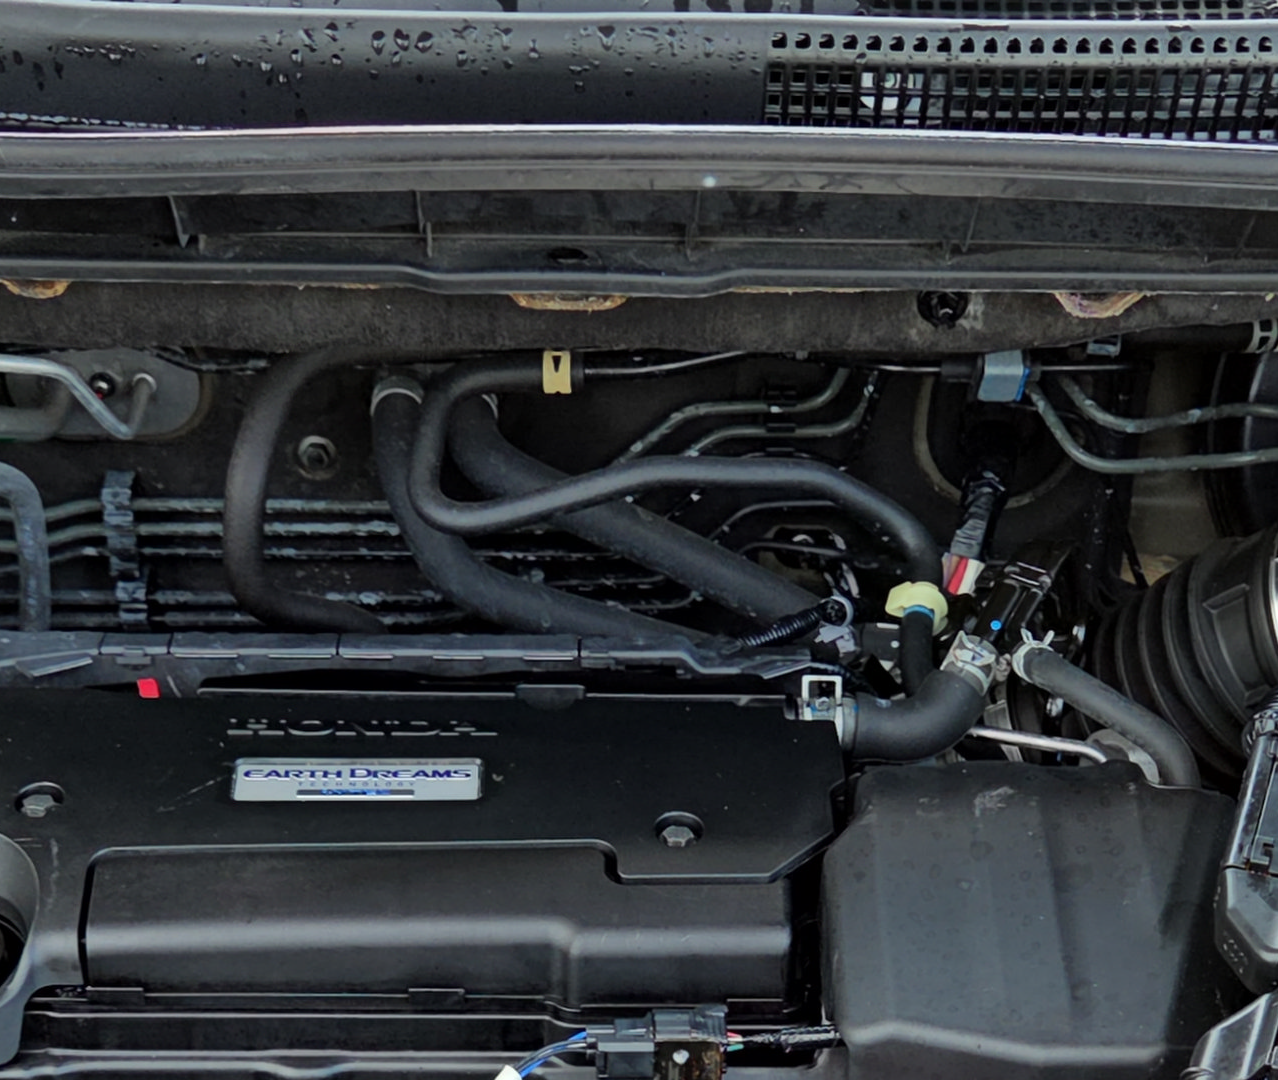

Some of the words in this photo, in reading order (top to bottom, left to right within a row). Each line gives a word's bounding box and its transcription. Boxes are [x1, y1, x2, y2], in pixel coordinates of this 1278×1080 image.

[226, 717, 498, 737] HONDA
[242, 769, 343, 779] EARTH
[349, 768, 472, 779] DREAMS
